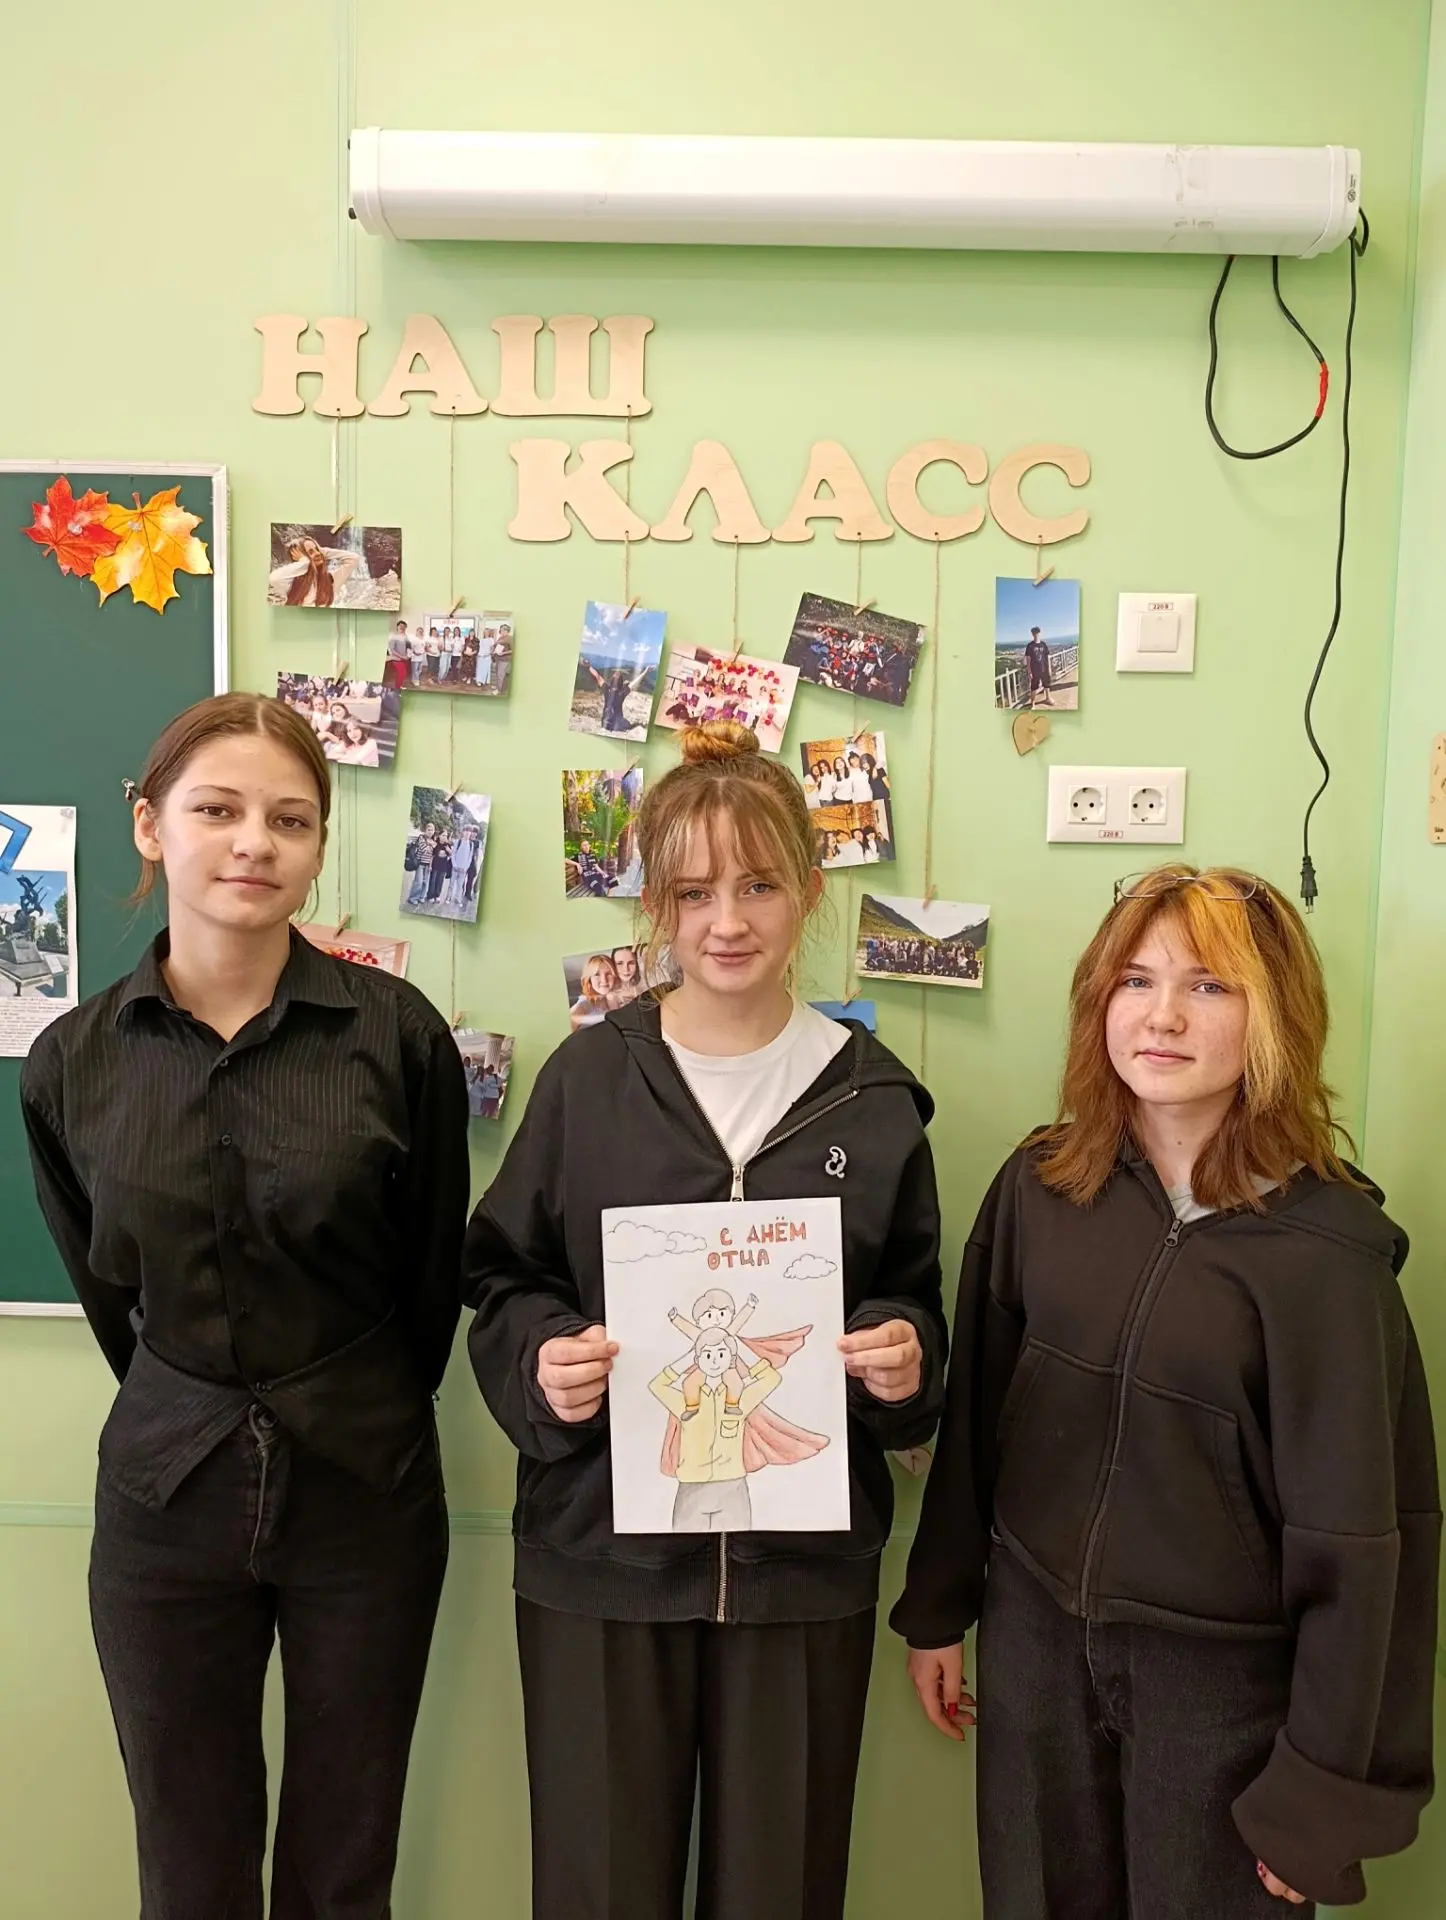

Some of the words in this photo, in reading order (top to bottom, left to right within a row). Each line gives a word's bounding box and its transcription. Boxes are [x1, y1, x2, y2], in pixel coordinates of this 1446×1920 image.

[252, 313, 655, 417] НАШ
[507, 438, 1092, 545] КЛАСС
[707, 1248, 770, 1271] ОТЦА
[719, 1227, 733, 1246] С
[746, 1216, 807, 1244] ДНЁМ
